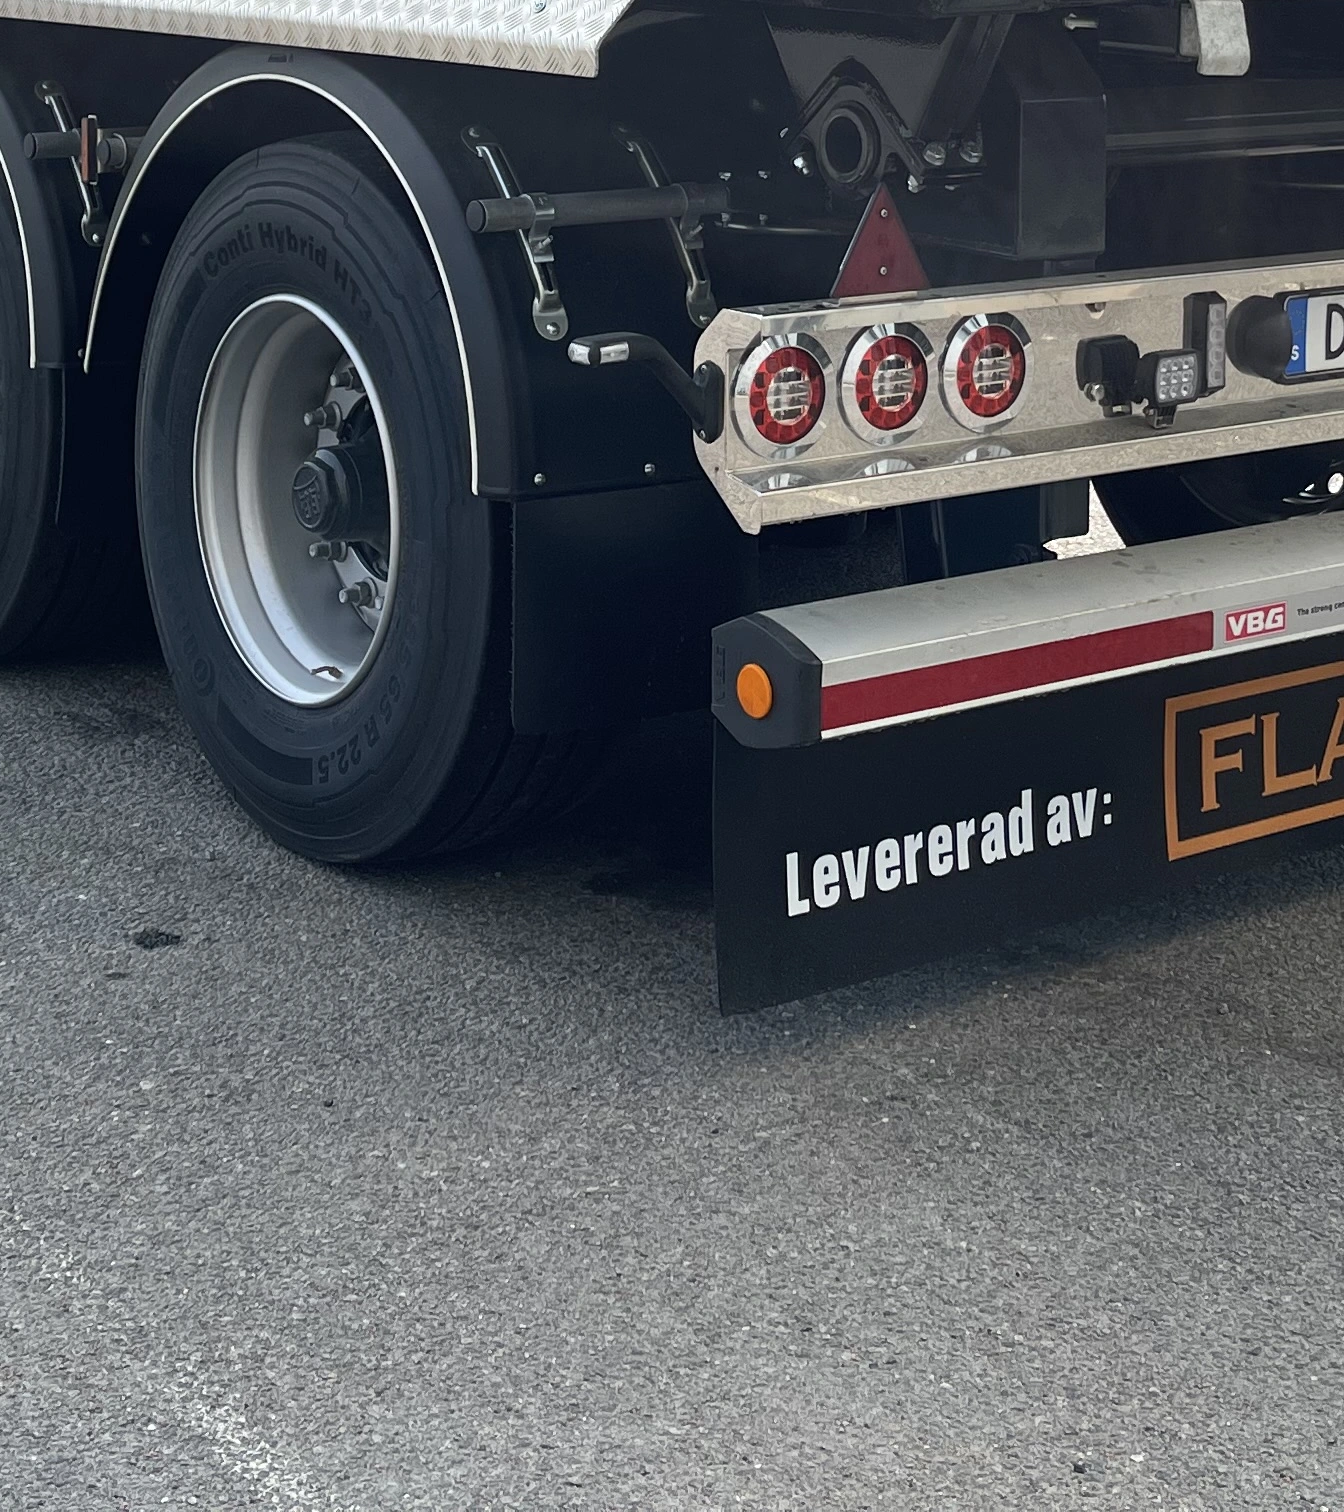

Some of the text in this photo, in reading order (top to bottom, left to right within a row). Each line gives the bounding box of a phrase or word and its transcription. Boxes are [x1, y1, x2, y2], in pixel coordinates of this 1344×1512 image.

[203, 221, 374, 325] Conti Hybrid HT3
[1290, 343, 1301, 362] S
[1227, 606, 1284, 637] VBG
[1296, 607, 1310, 617] The
[1310, 602, 1333, 614] strong
[316, 732, 363, 785] 22.5
[785, 787, 1113, 917] Levererad av:
